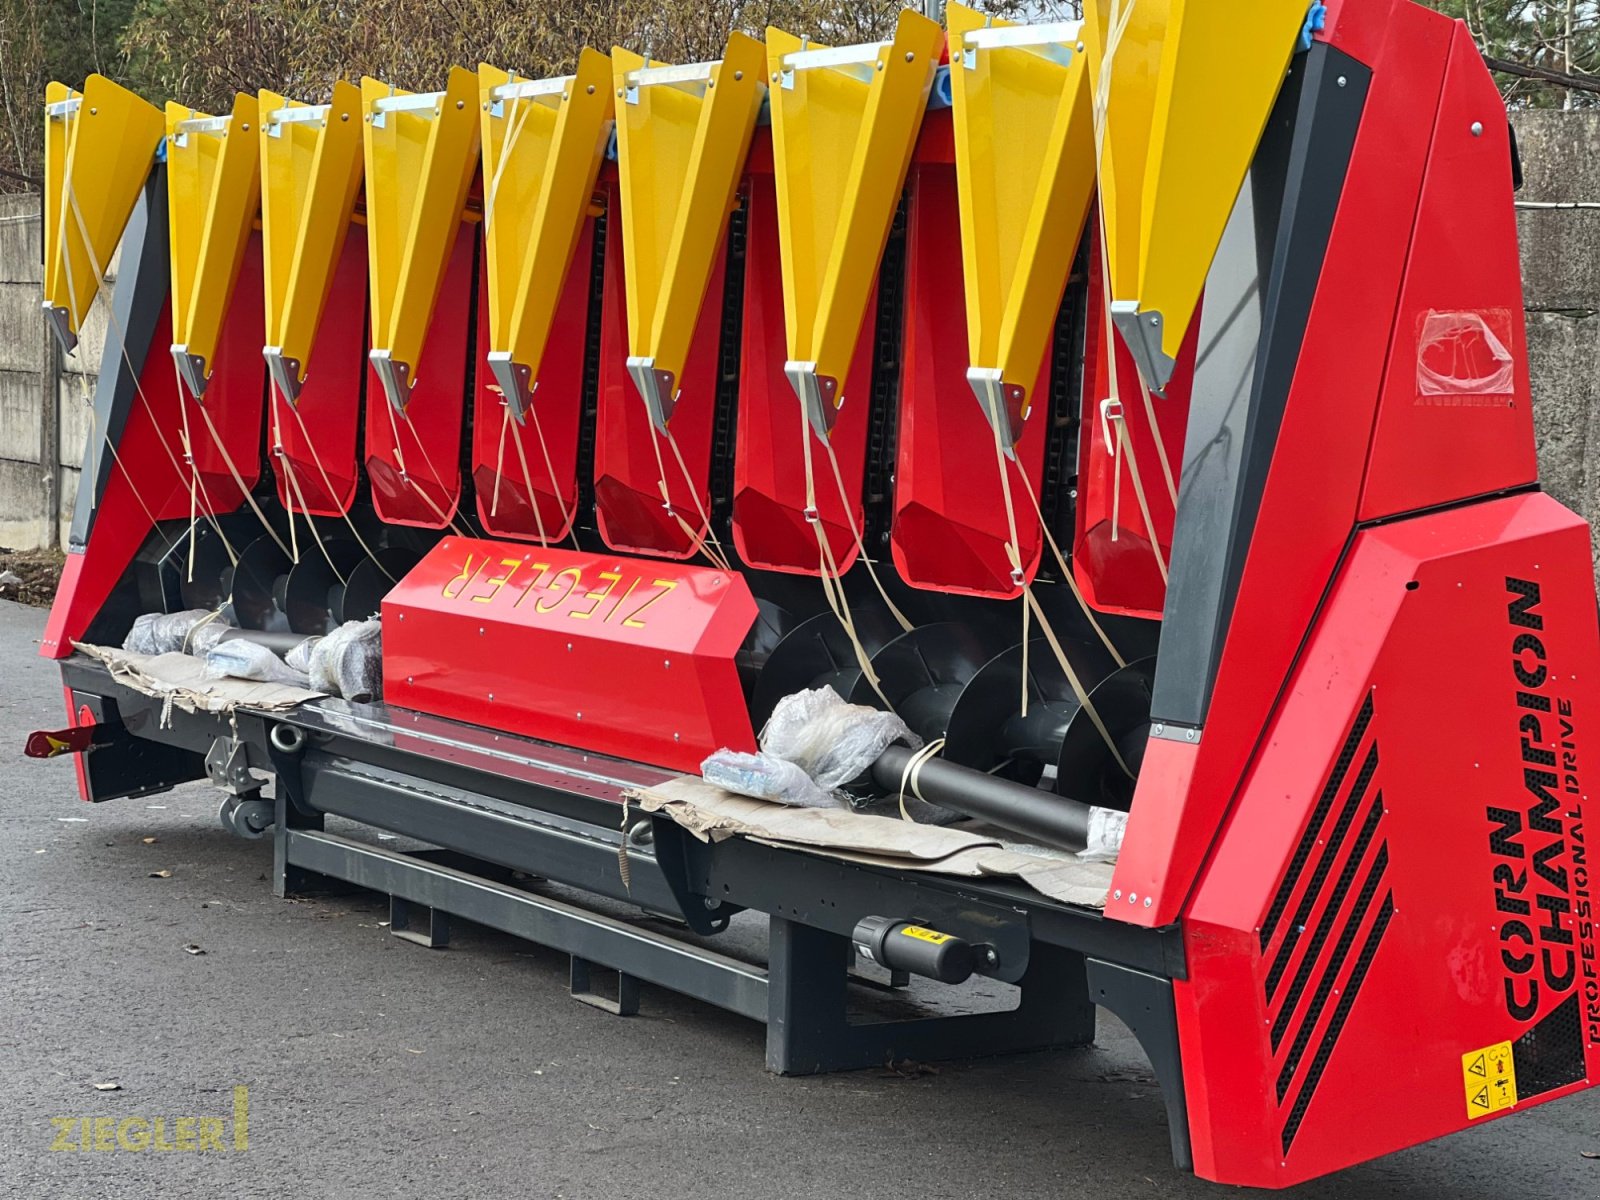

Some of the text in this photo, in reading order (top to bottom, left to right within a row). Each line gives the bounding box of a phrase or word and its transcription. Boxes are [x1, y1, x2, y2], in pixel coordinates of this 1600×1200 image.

[441, 553, 679, 628] ZIEGLER
[1486, 806, 1539, 1022] CORN
[1505, 576, 1576, 992] CHAMPION
[1557, 698, 1600, 1044] PROFESSIONAL DRIVE
